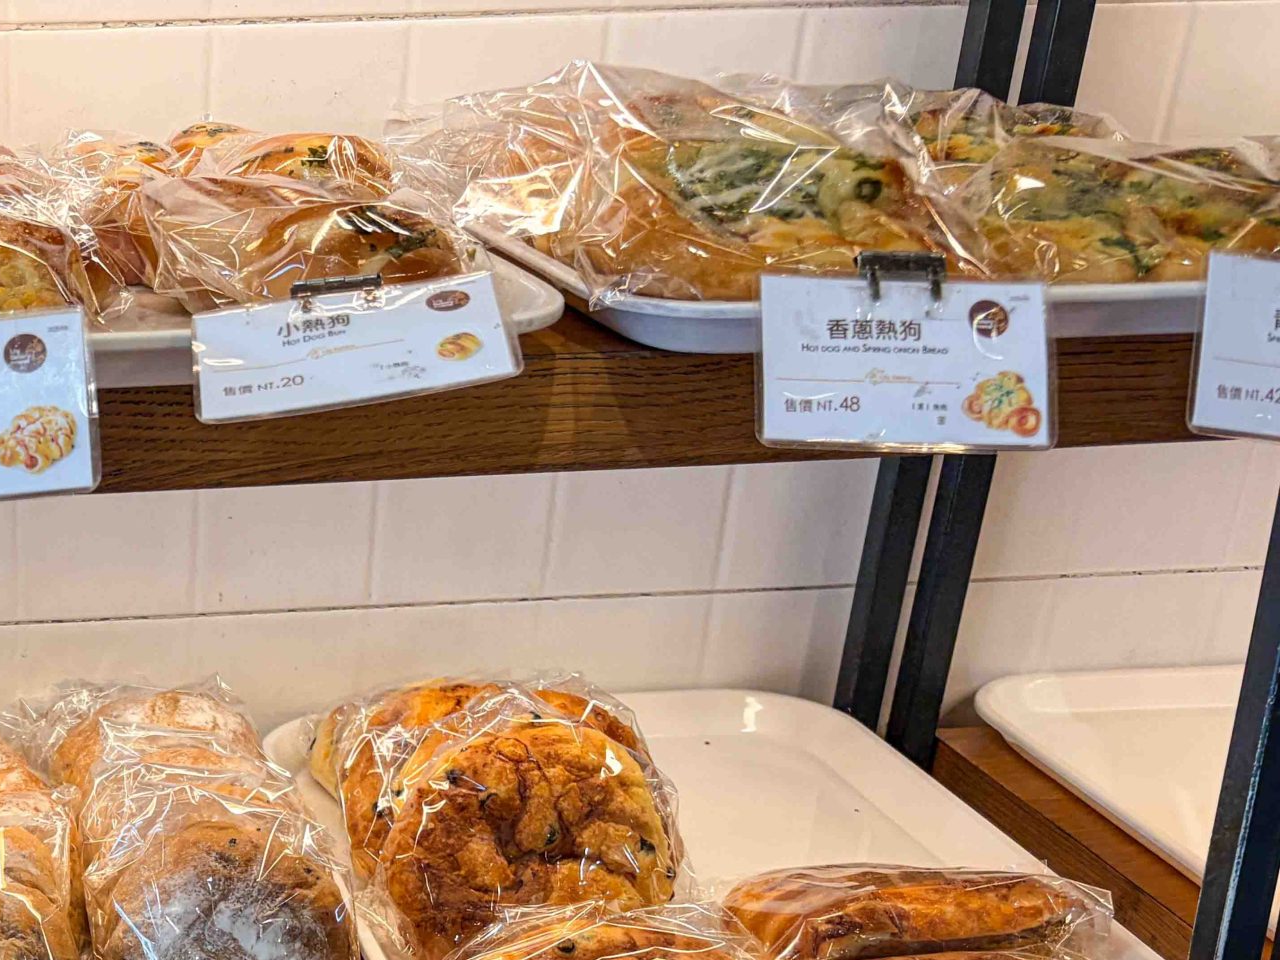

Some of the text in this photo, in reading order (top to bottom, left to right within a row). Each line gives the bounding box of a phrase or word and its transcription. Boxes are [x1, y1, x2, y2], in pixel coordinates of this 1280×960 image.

[277, 313, 350, 338] 小熱狗
[223, 375, 304, 396] 售價 NT.20
[784, 396, 860, 413] 售價 NT.48
